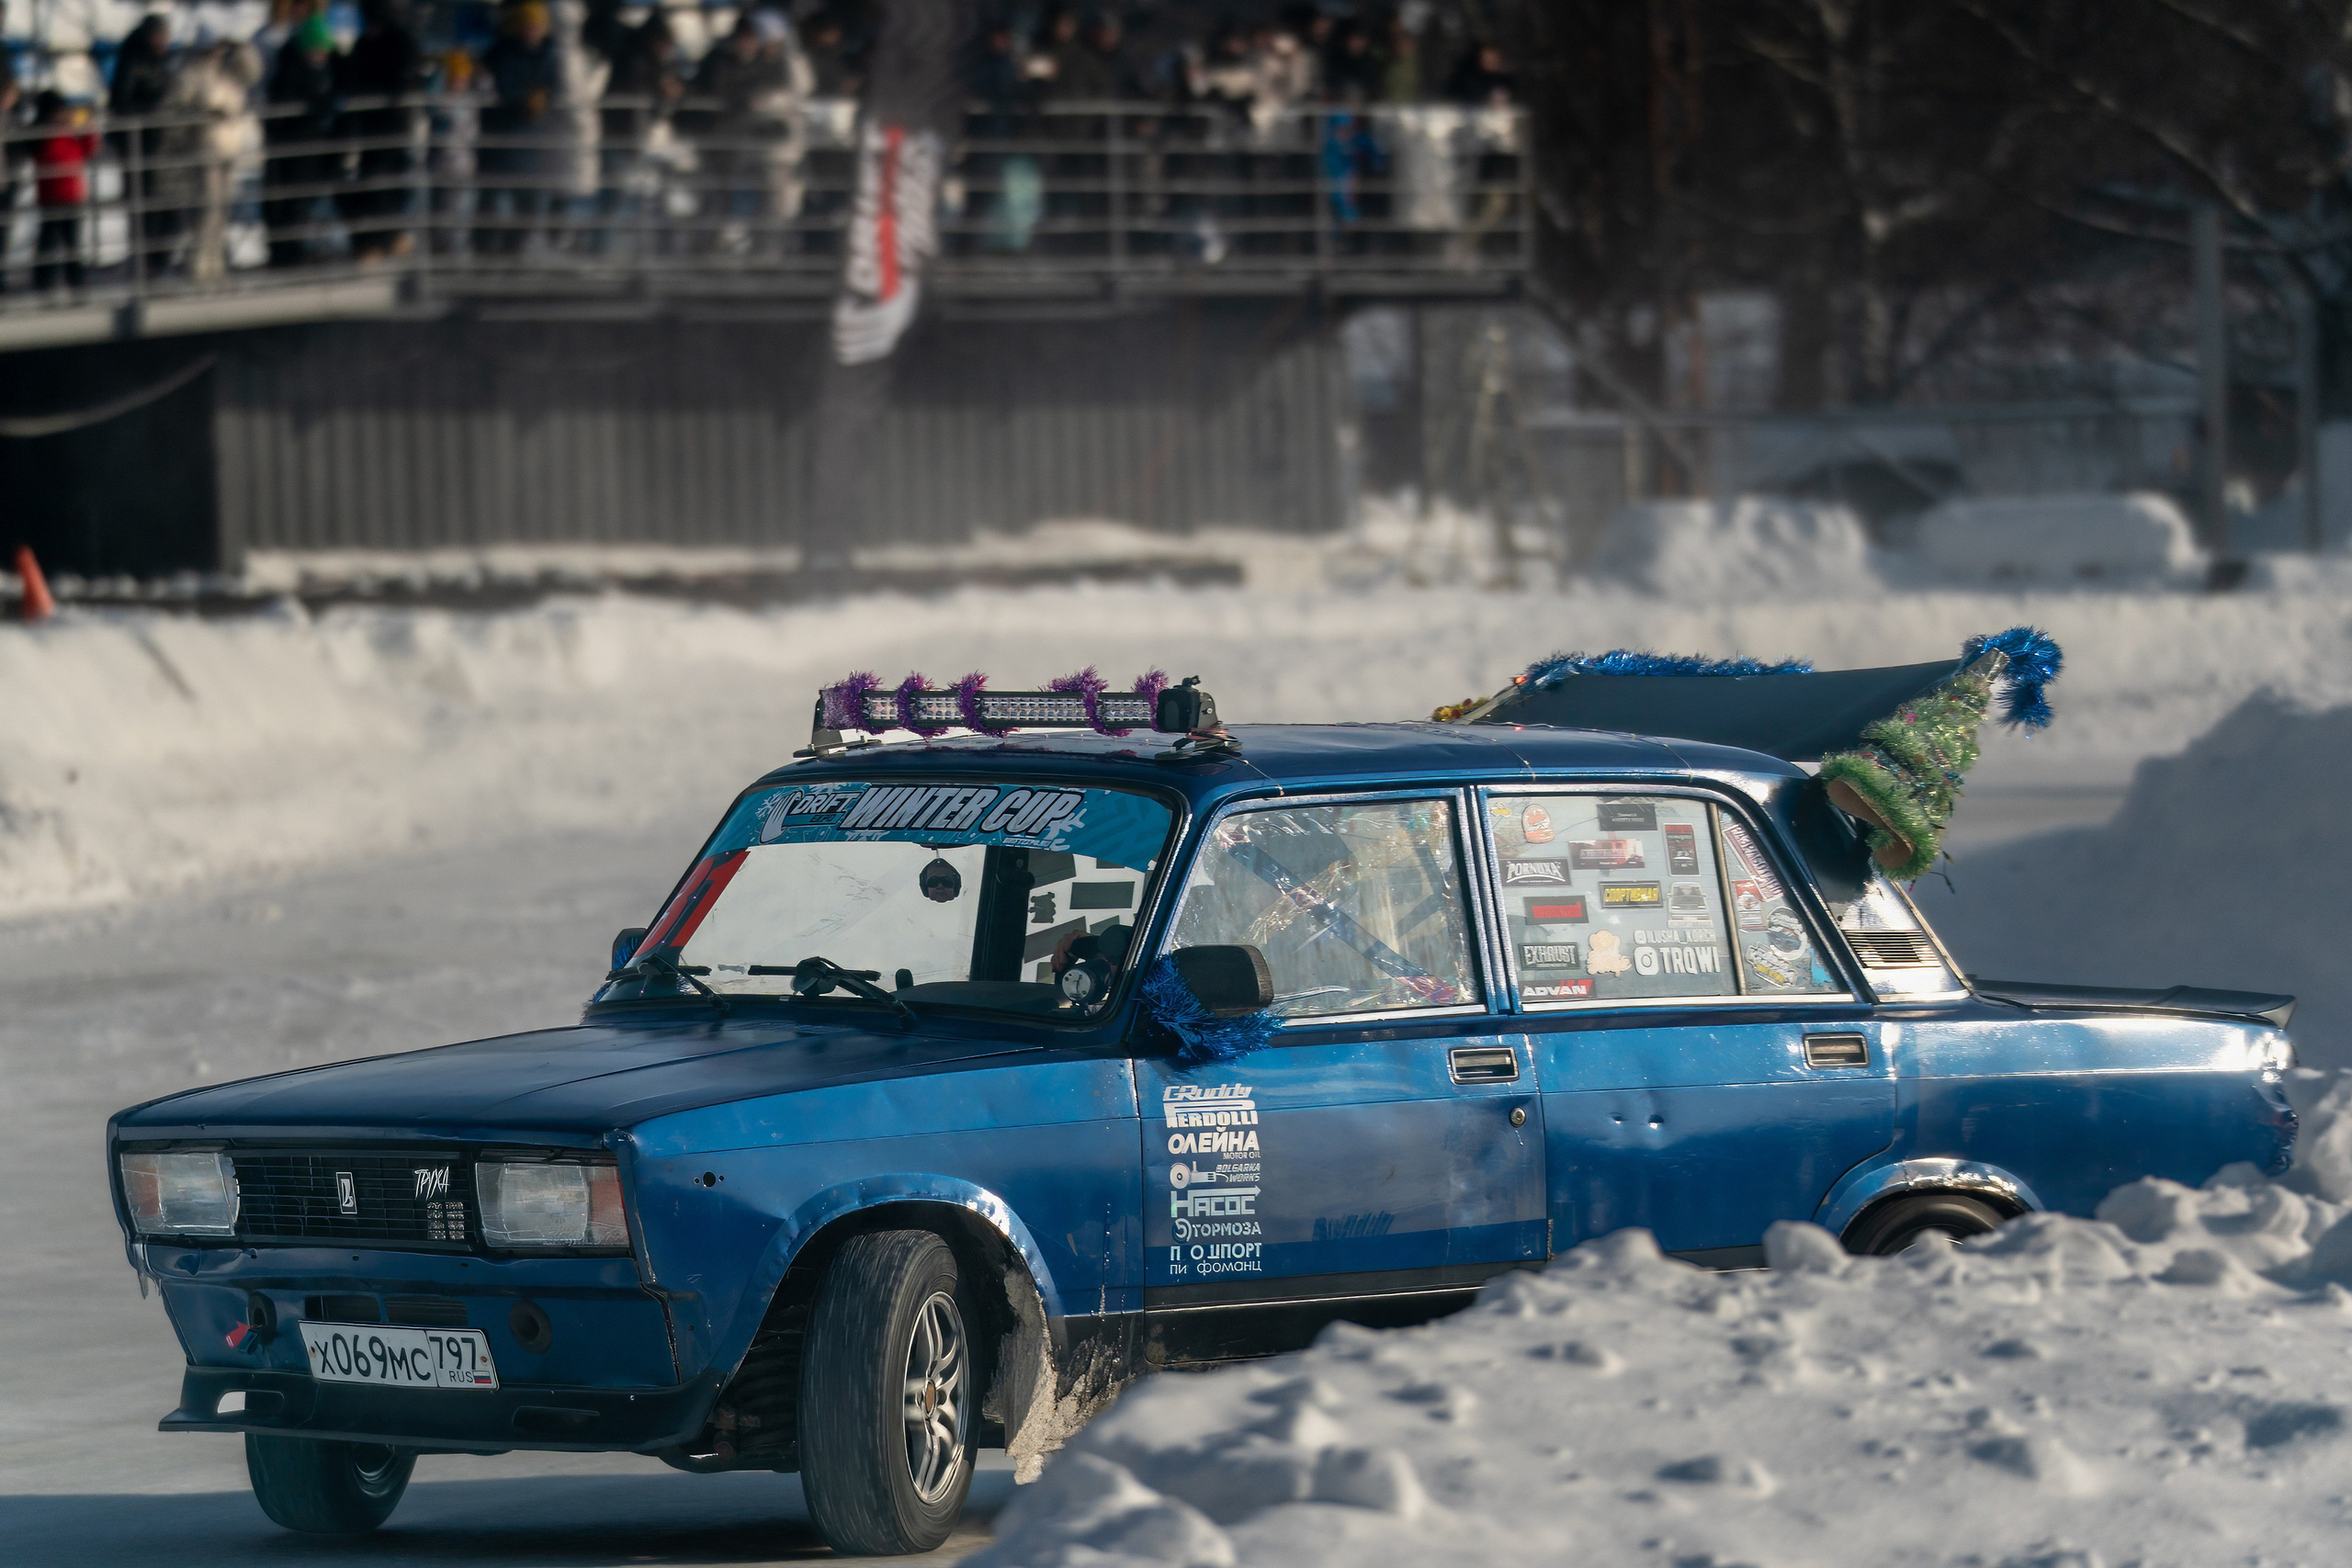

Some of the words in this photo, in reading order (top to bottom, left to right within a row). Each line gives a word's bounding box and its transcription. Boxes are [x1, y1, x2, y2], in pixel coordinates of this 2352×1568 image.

[791, 793, 861, 815] DRIFT
[842, 785, 999, 830] WINTER
[982, 789, 1080, 834] CUP
[1523, 945, 1576, 965] EXHAUST
[1521, 985, 1588, 997] ADVAN
[1168, 1126, 1260, 1155] ОЛЕЙНА
[1223, 1152, 1248, 1160] MOTOR
[1249, 1151, 1261, 1159] OIL
[1192, 1221, 1262, 1237] ТОРМОЗА
[429, 1337, 477, 1371] 797
[449, 1371, 473, 1383] RUS
